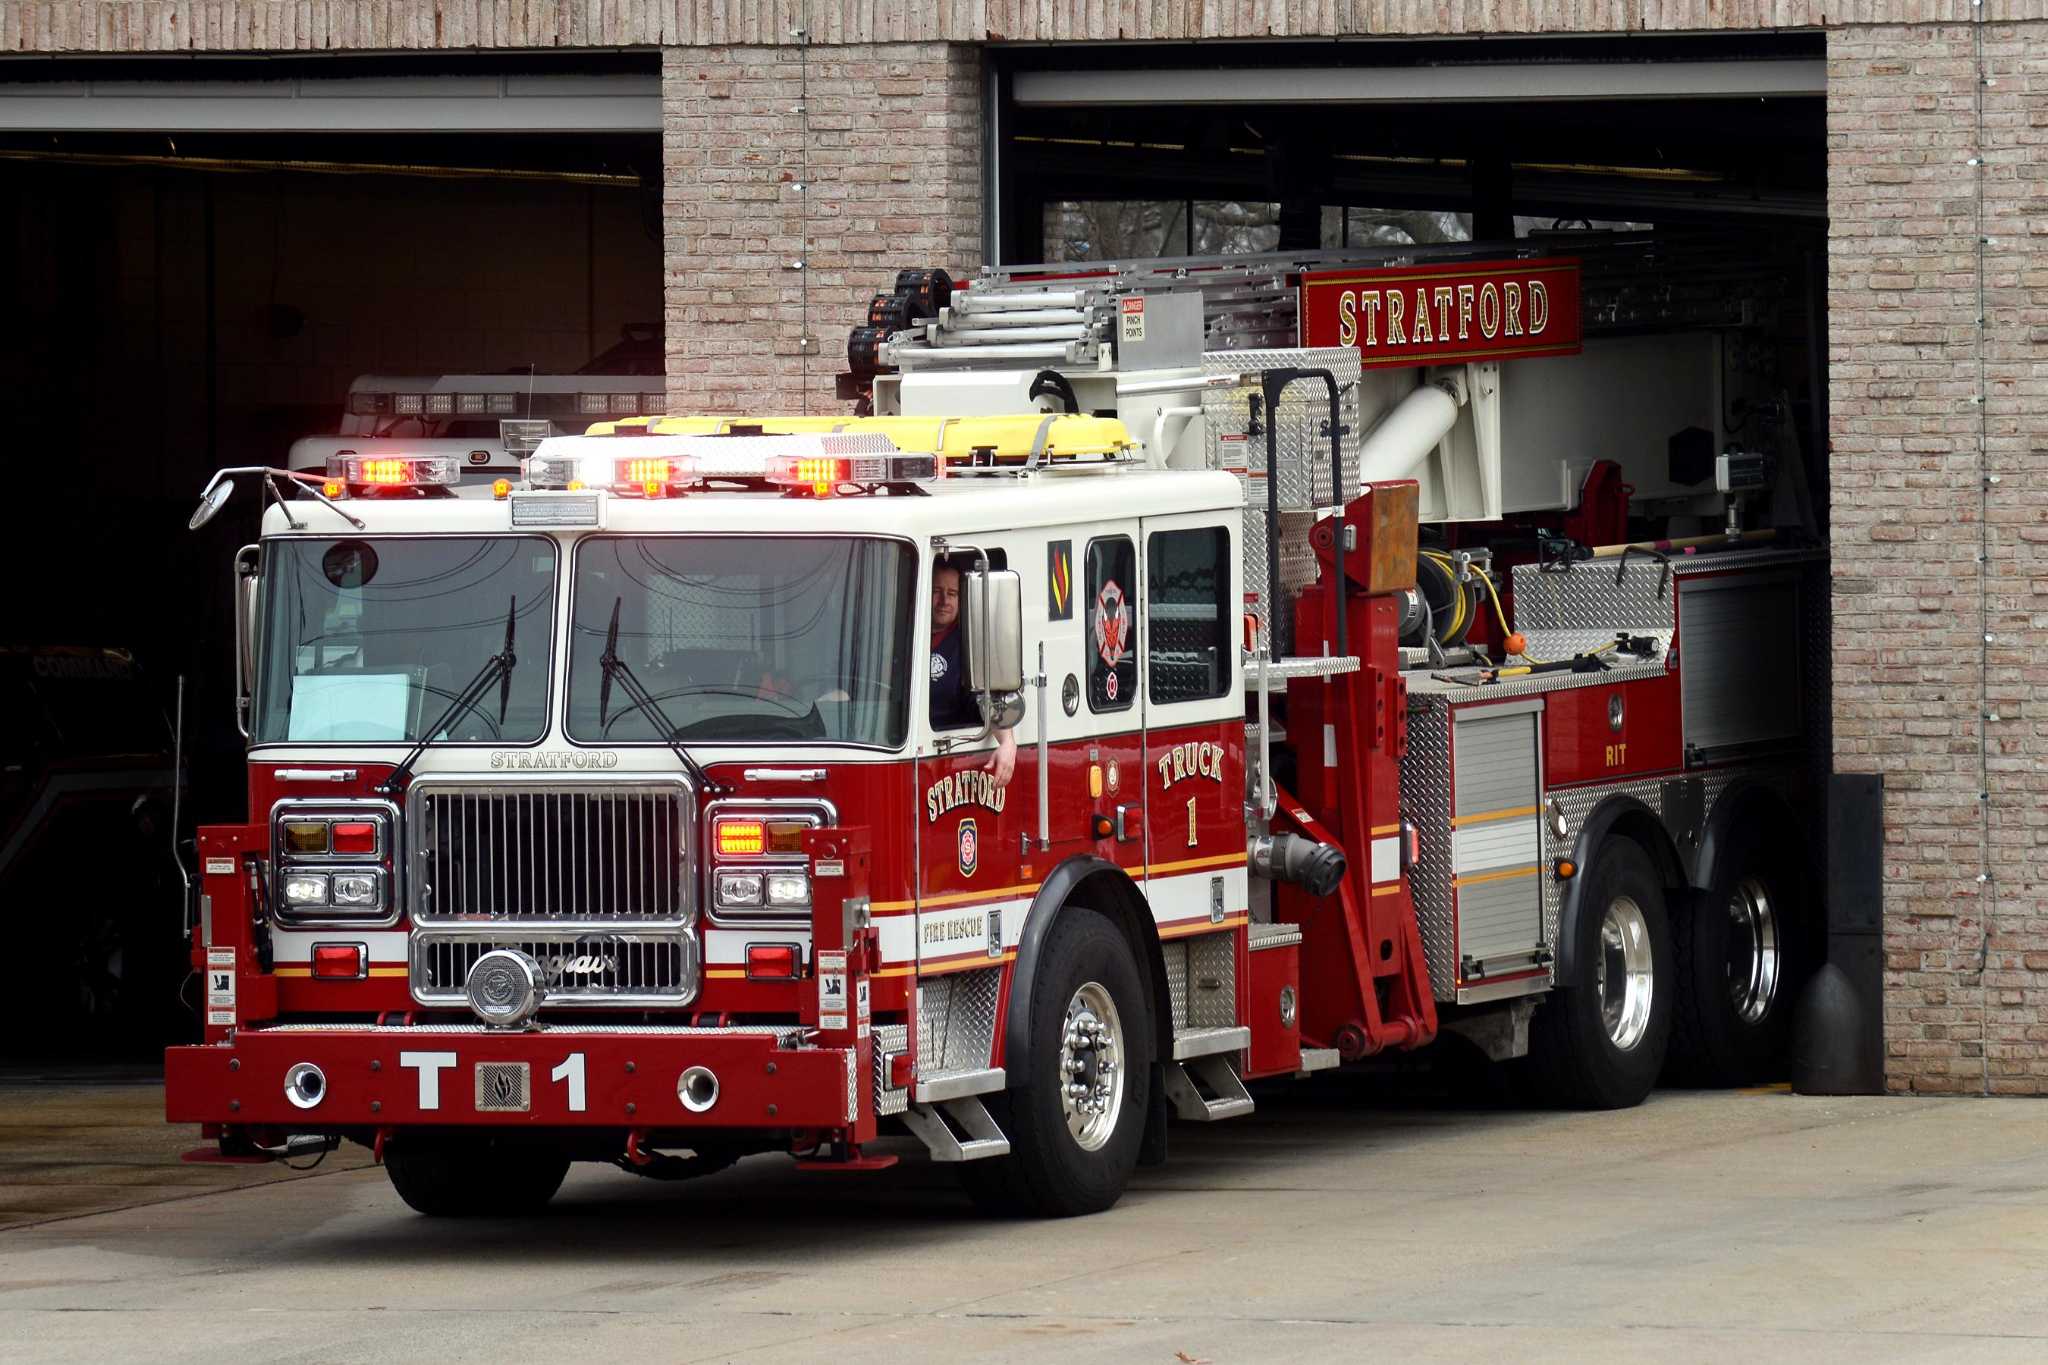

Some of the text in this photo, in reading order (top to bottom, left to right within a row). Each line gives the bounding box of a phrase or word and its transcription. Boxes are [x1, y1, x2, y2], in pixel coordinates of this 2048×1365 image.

[1125, 327, 1143, 337] POINTS
[1126, 315, 1141, 325] PINCH
[1339, 281, 1548, 347] STRATFORD
[490, 752, 618, 769] STRATFORD
[1159, 742, 1224, 790] TRUCK
[1605, 743, 1627, 767] RIT
[928, 770, 1006, 823] STRATFORD
[1187, 796, 1198, 847] 1
[924, 915, 982, 944] FIRE RESCUE
[400, 1052, 586, 1111] T 1
